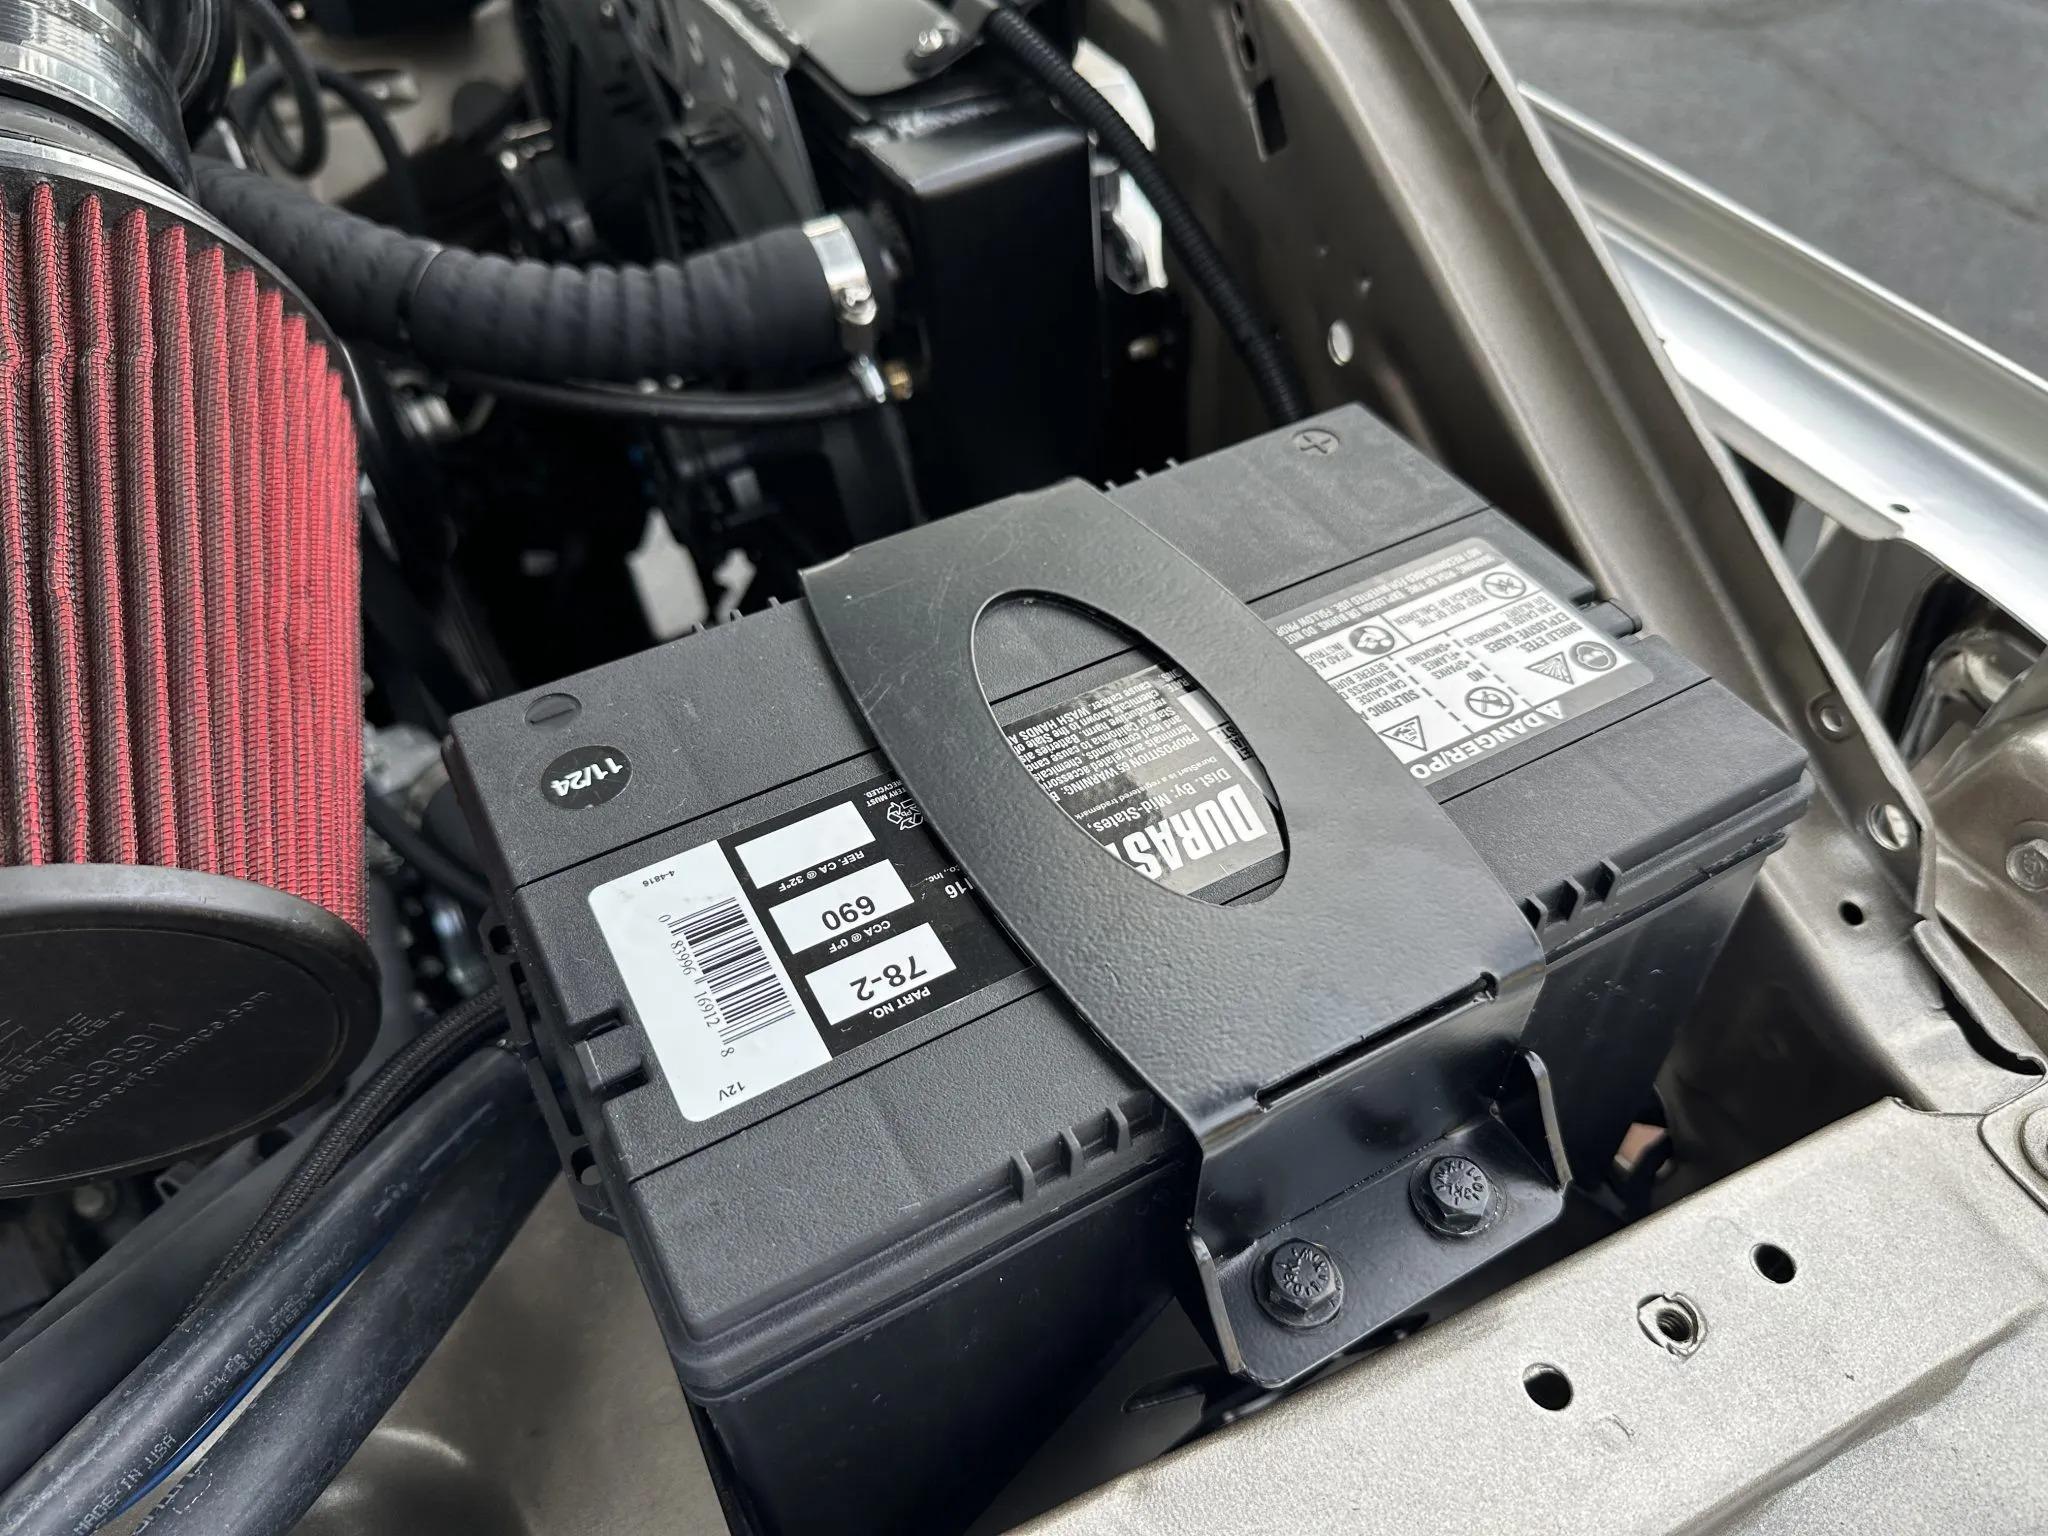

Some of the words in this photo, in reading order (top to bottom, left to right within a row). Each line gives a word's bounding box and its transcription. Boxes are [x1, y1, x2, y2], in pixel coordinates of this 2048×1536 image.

[1296, 607, 1333, 627] FOLLOW
[1513, 611, 1571, 640] EXPLOSIVE
[1462, 621, 1512, 646] BLINDNESS
[1543, 621, 1583, 642] SHIELD
[1482, 633, 1519, 653] GASES
[1352, 662, 1389, 681] SEVERE
[1465, 669, 1486, 682] NO
[1121, 679, 1152, 697] cause
[1346, 670, 1398, 696] BLINDNESS
[1384, 678, 1407, 692] CAN
[1087, 691, 1123, 712] cancer.
[1110, 688, 1160, 714] chemicals
[1355, 686, 1388, 705] CAUSE
[1366, 689, 1420, 717] SULFURIC
[1056, 705, 1089, 725] WASH
[1078, 707, 1112, 728] known
[1107, 696, 1167, 727] reproductive
[1137, 715, 1150, 727] of
[1148, 705, 1175, 722] State
[1161, 713, 1183, 729] and
[1018, 719, 1057, 741] HANDS
[1051, 725, 1070, 739] the
[1068, 721, 1080, 732] to
[1078, 720, 1110, 740] harm.
[1091, 720, 1138, 746] California
[1140, 721, 1164, 738] lead
[1143, 722, 1191, 748] terminals
[1024, 732, 1053, 750] State
[1033, 733, 1079, 759] Batteries
[1079, 740, 1092, 751] to
[1081, 729, 1142, 763] compounds,
[1124, 741, 1146, 757] and
[1128, 731, 1199, 768] PROPOSITION
[1049, 744, 1080, 763] cause
[1089, 749, 1126, 771] related
[549, 754, 625, 799] 11/24
[1116, 760, 1131, 773] 65
[1060, 766, 1118, 797] WARNING:
[1194, 766, 1231, 790] Dist.
[866, 794, 888, 807] MUST
[1168, 779, 1196, 801] By:
[1073, 797, 1118, 820] trademark
[1086, 790, 1171, 836] Mid-States,
[819, 858, 837, 872] CA
[838, 850, 865, 866] REF.
[642, 870, 675, 887] 4-4816
[924, 872, 944, 882] Inc.
[821, 895, 875, 931] 690
[863, 920, 891, 937] CCA
[658, 914, 671, 923] 0
[670, 941, 695, 976] 83996
[694, 991, 721, 1028] 16912
[721, 1047, 735, 1058] 8
[849, 955, 927, 1001] 78-2
[902, 985, 931, 1008] PART
[868, 997, 900, 1019] NO.
[718, 1080, 746, 1101] 12V
[123, 1468, 143, 1490] IN
